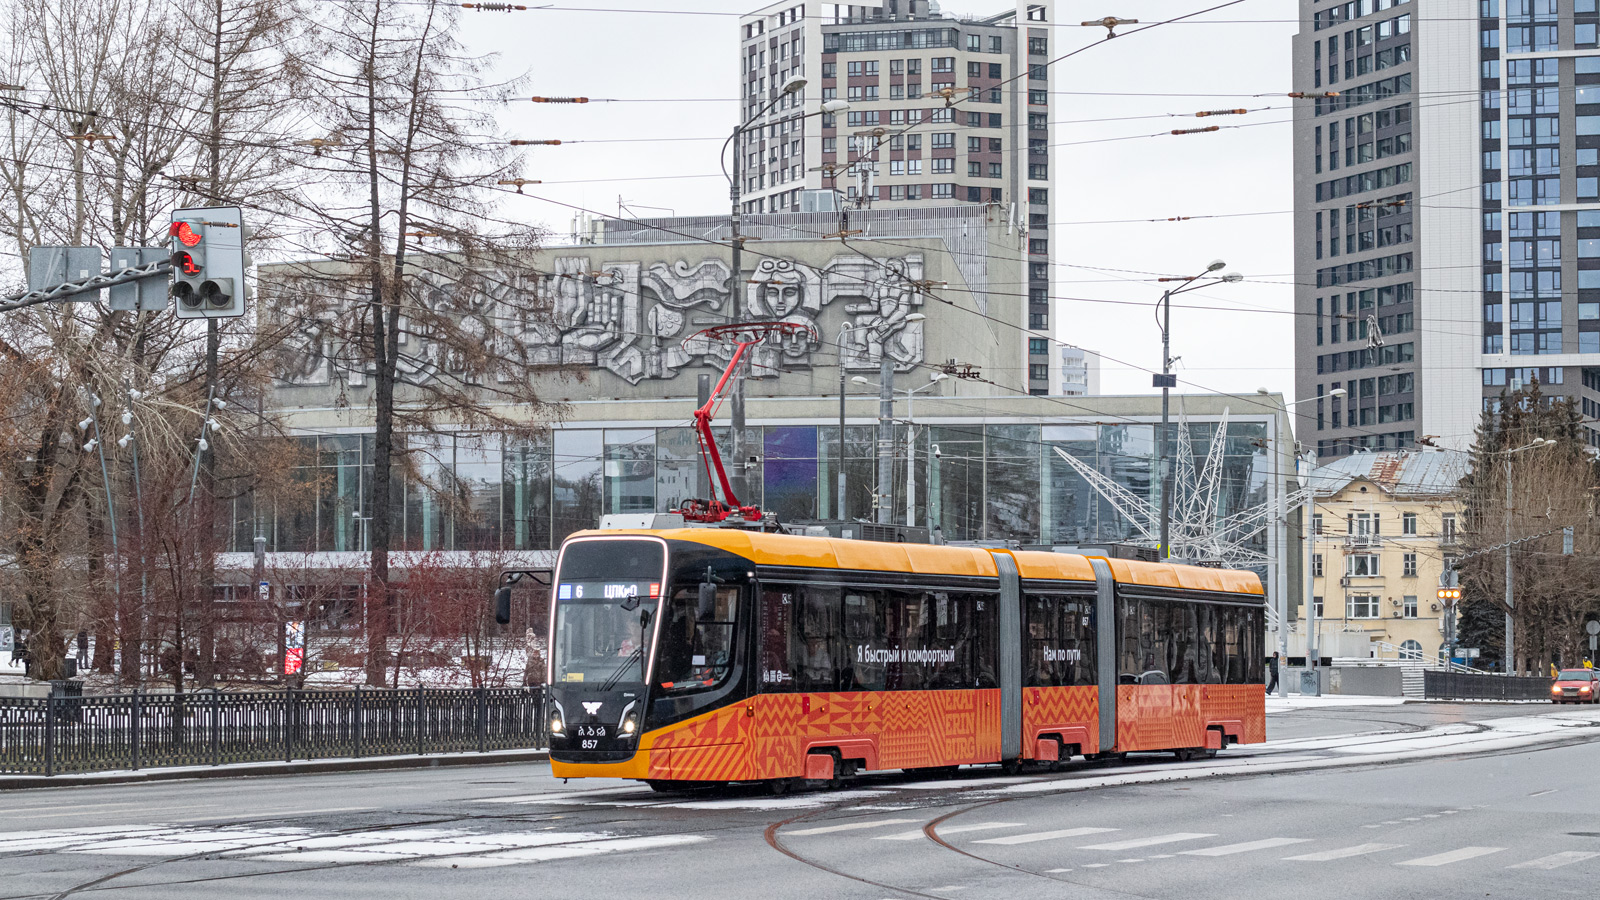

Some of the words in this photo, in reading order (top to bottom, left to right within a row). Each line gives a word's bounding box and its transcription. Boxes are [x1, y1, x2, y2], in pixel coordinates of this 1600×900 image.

[575, 585, 583, 598] 6
[857, 645, 863, 662] Я
[865, 644, 900, 667] быстрый
[901, 649, 907, 662] и
[908, 644, 955, 667] комфортный
[1043, 645, 1057, 661] Нам
[1058, 649, 1066, 661] по
[1067, 649, 1081, 665] пути
[945, 690, 976, 710] ERAT
[945, 712, 975, 735] ERIN
[581, 739, 598, 749] 857
[945, 736, 975, 760] BURG
